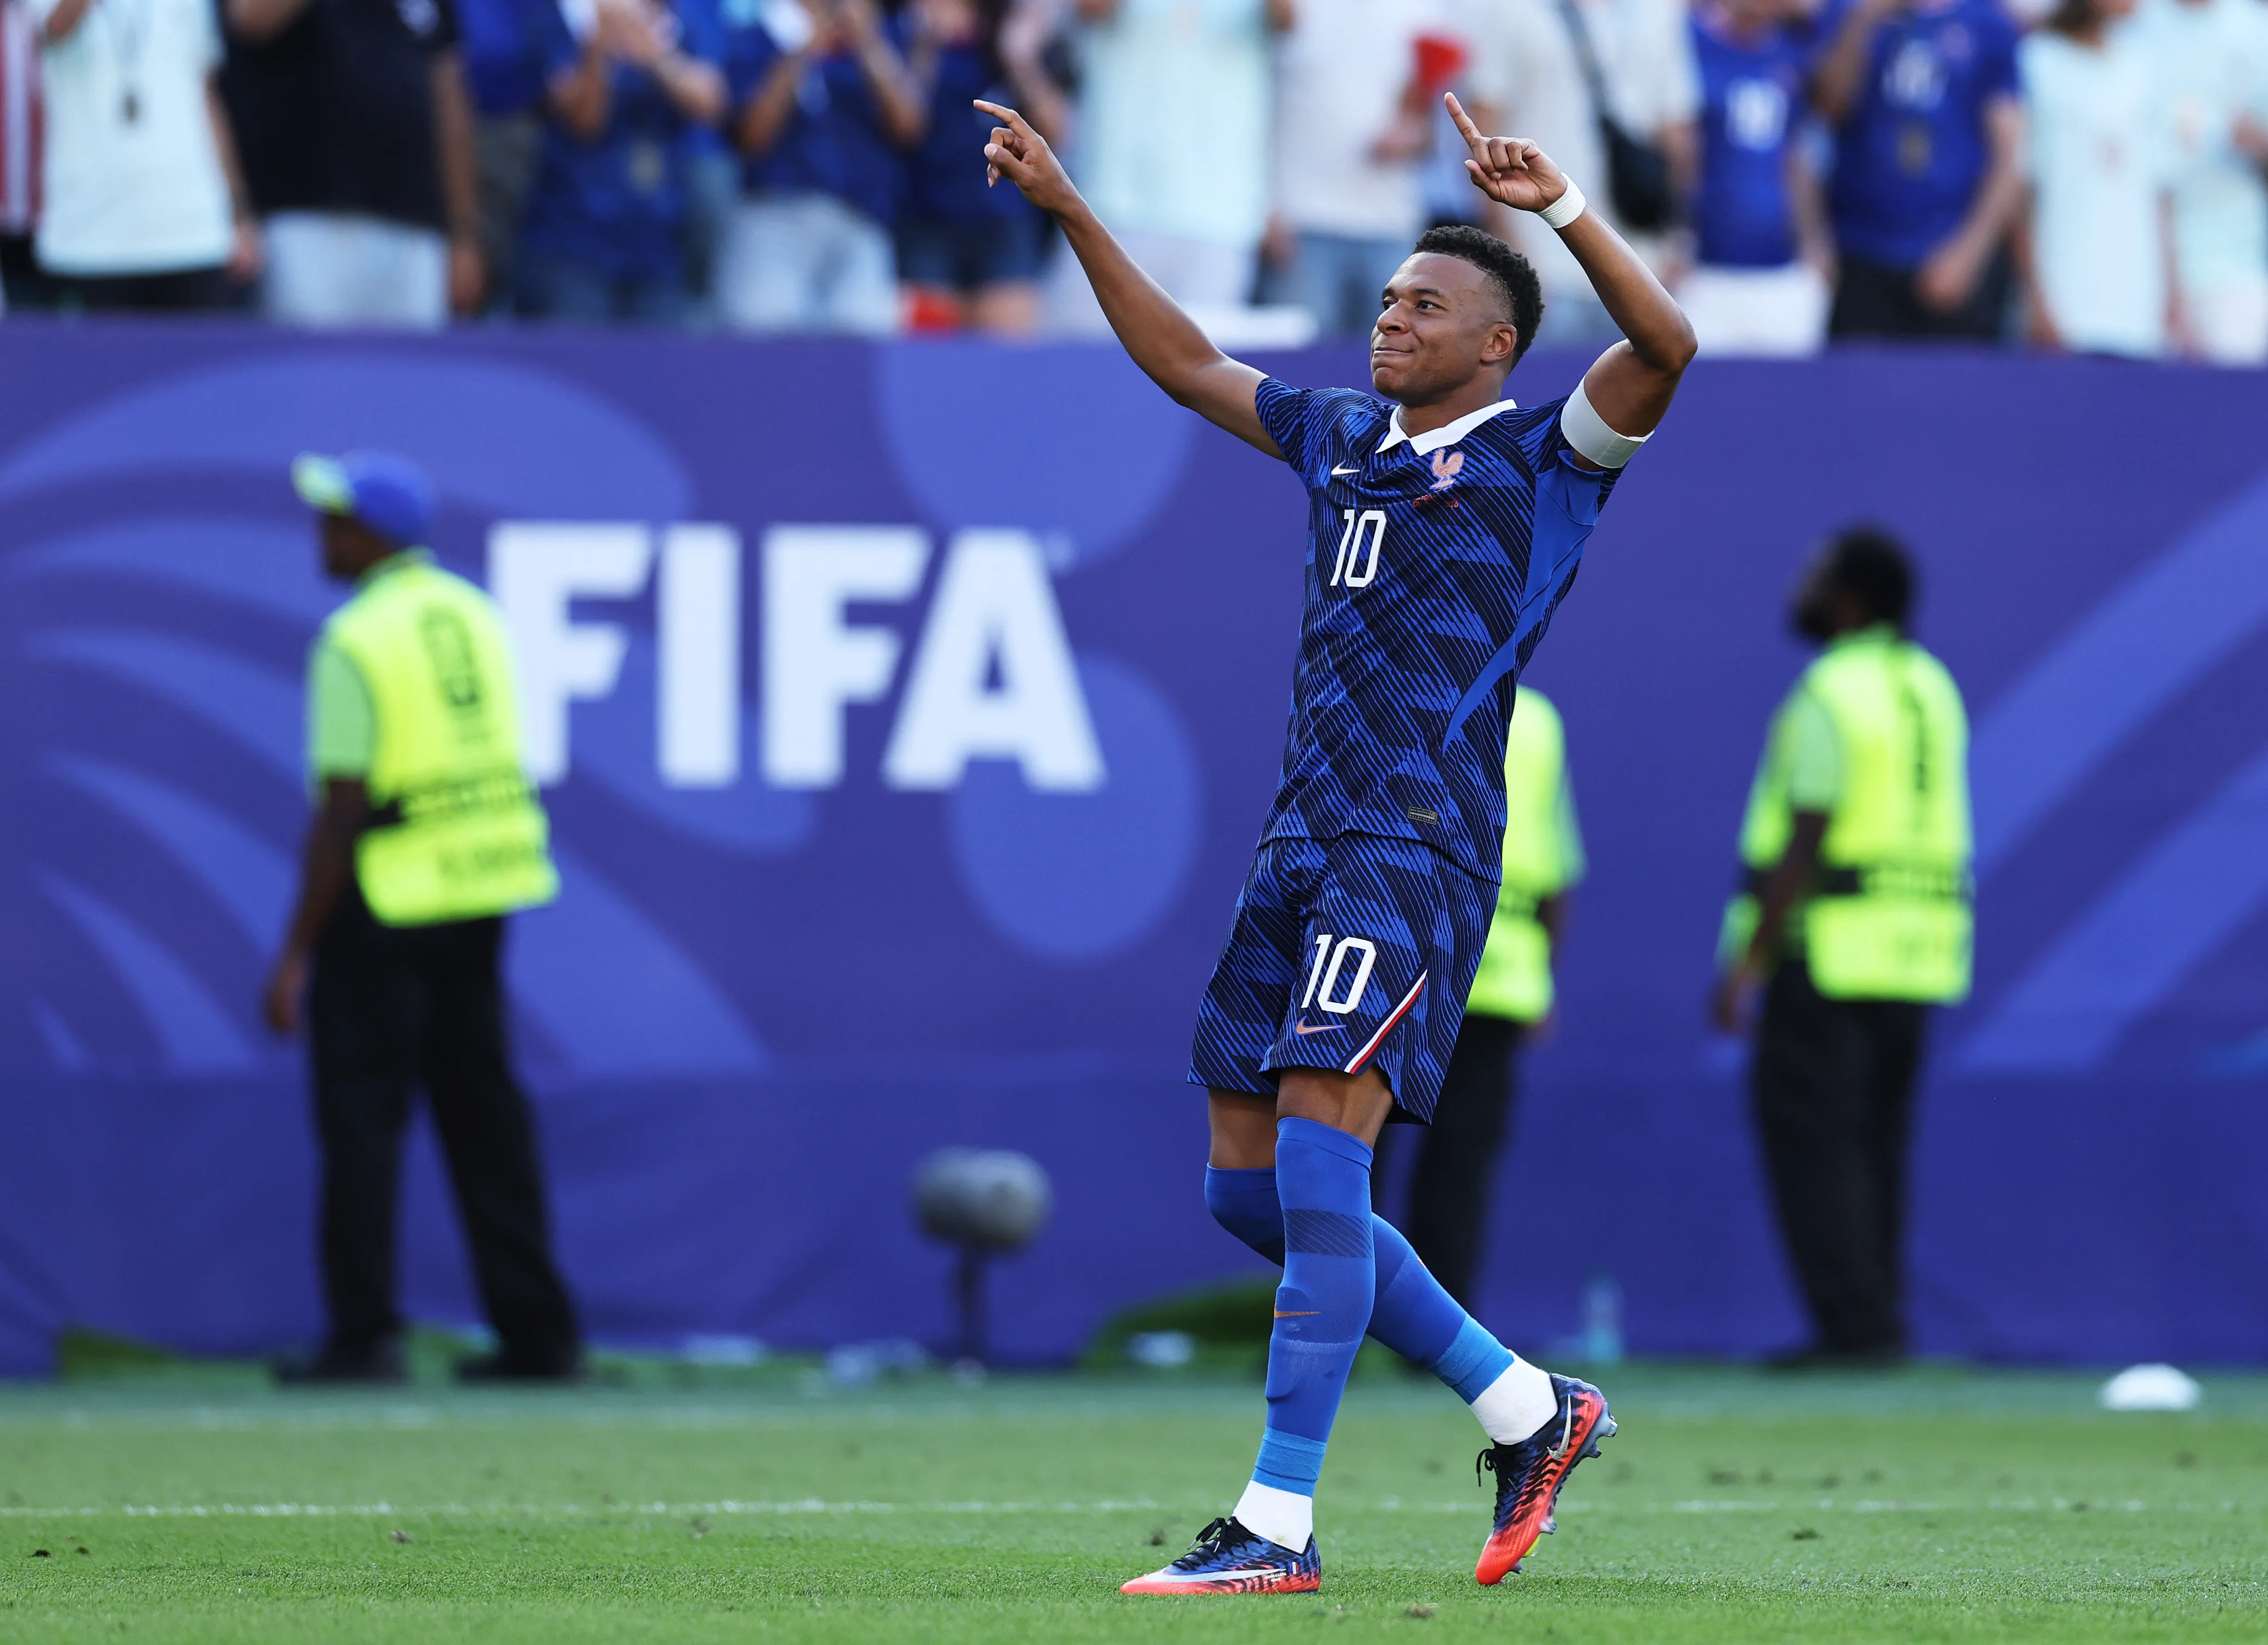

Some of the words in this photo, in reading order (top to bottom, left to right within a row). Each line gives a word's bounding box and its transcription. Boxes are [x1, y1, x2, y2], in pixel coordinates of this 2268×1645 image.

[1330, 509, 1387, 587] 10
[491, 523, 1104, 791] FIFA
[1301, 934, 1377, 1014] 10
